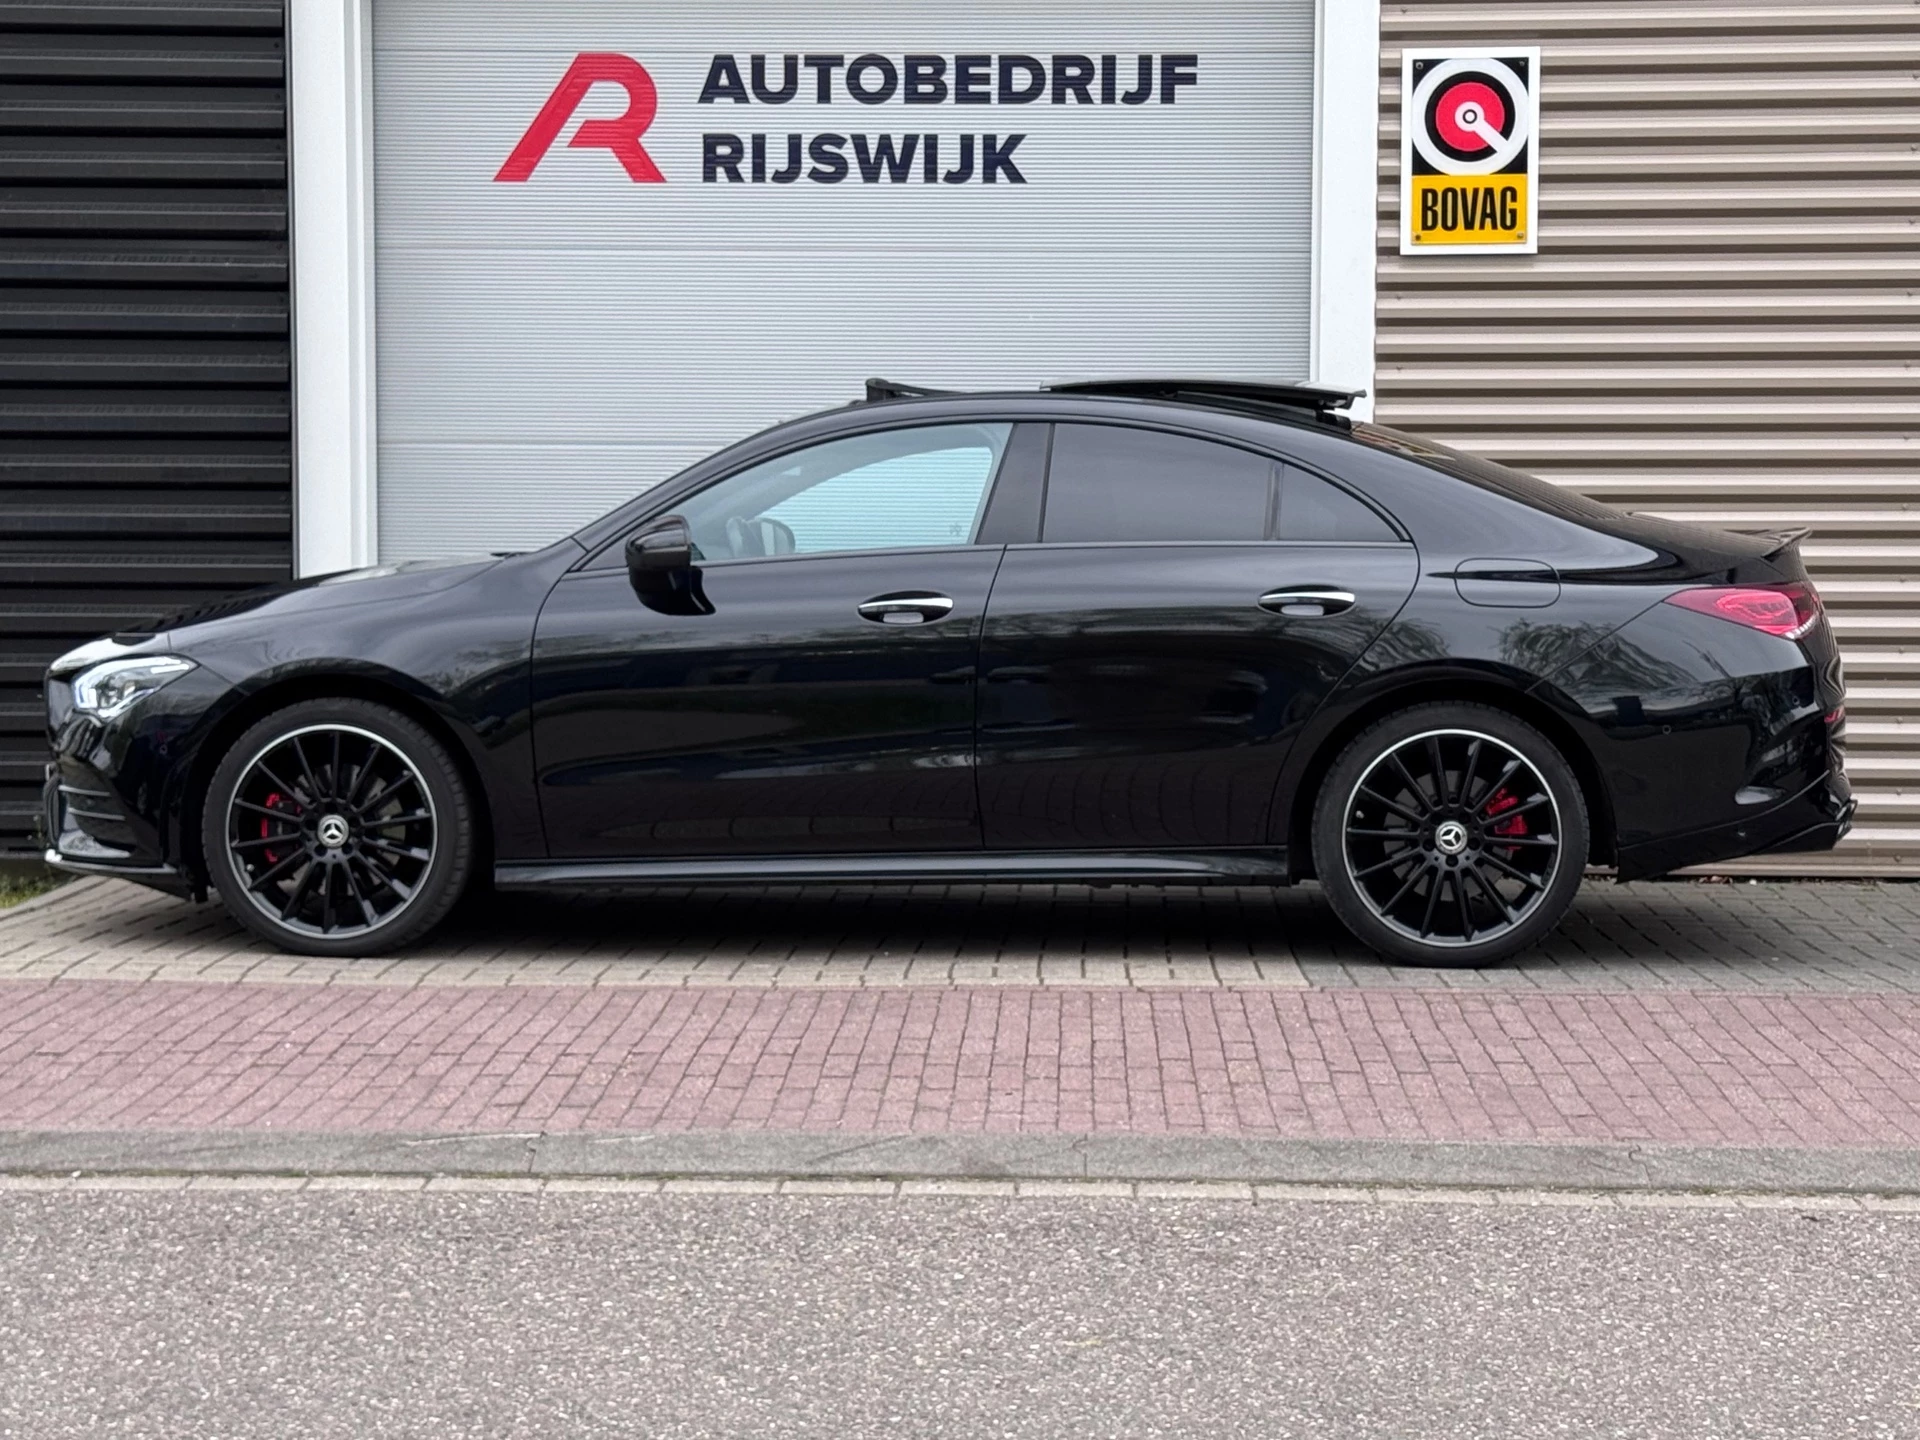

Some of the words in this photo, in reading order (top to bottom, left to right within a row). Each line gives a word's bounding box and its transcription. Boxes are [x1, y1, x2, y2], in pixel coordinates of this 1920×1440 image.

[698, 53, 1199, 105] AUTOBEDRIJF
[702, 132, 1027, 185] RIJSWIJK
[1421, 186, 1518, 231] BOVAG
